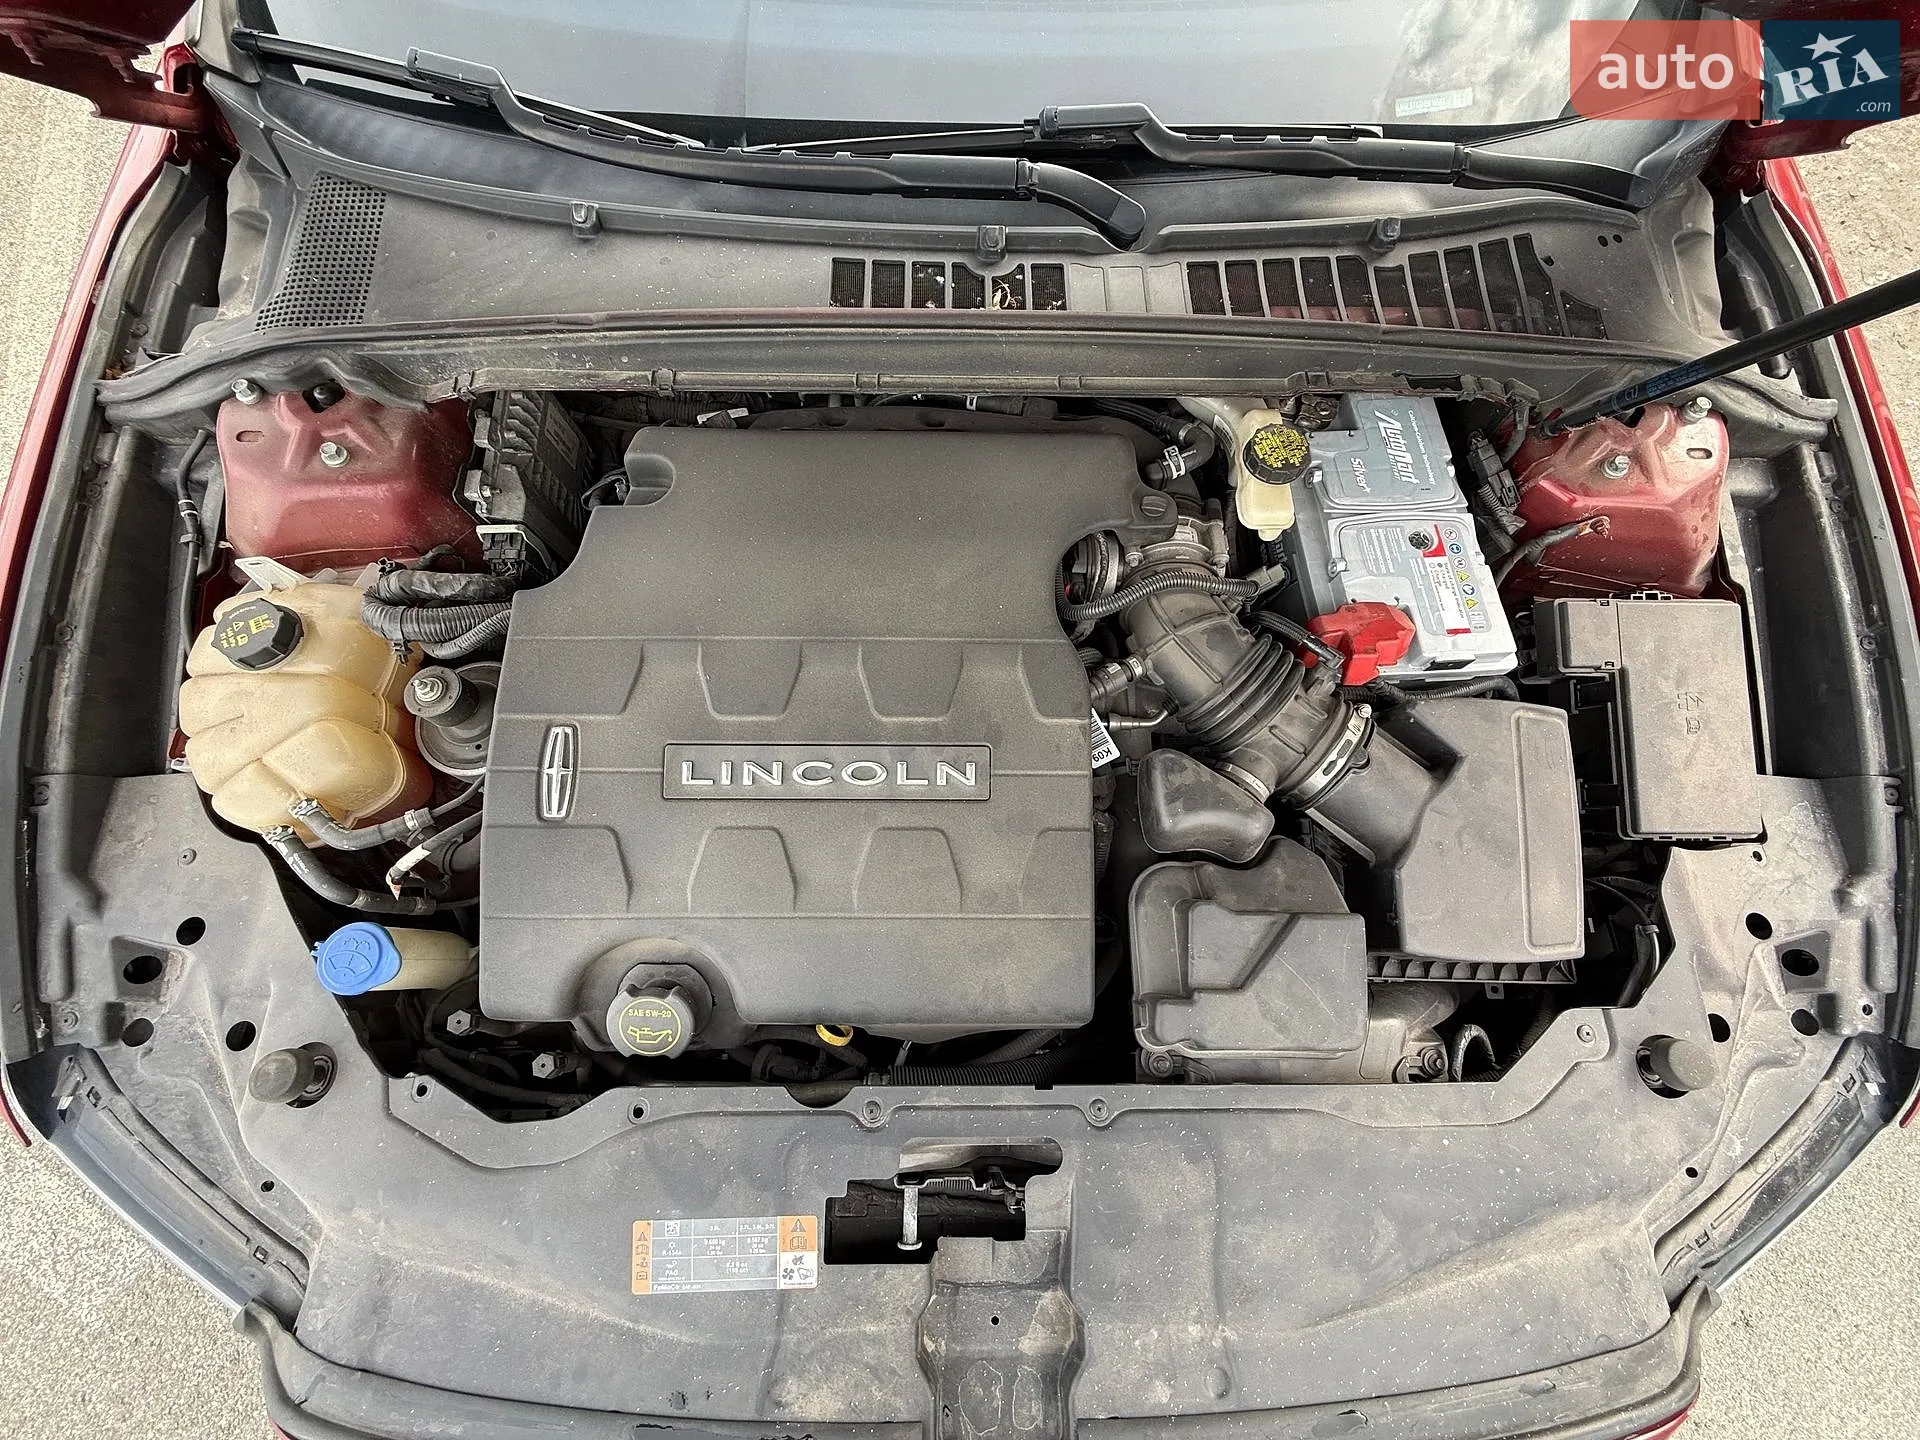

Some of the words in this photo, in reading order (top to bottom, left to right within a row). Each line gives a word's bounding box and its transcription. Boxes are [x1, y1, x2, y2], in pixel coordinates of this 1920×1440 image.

[1092, 747, 1113, 762] K09
[681, 760, 977, 787] LINCOLN
[628, 1008, 645, 1017] SAE
[645, 1009, 672, 1018] 5W-20
